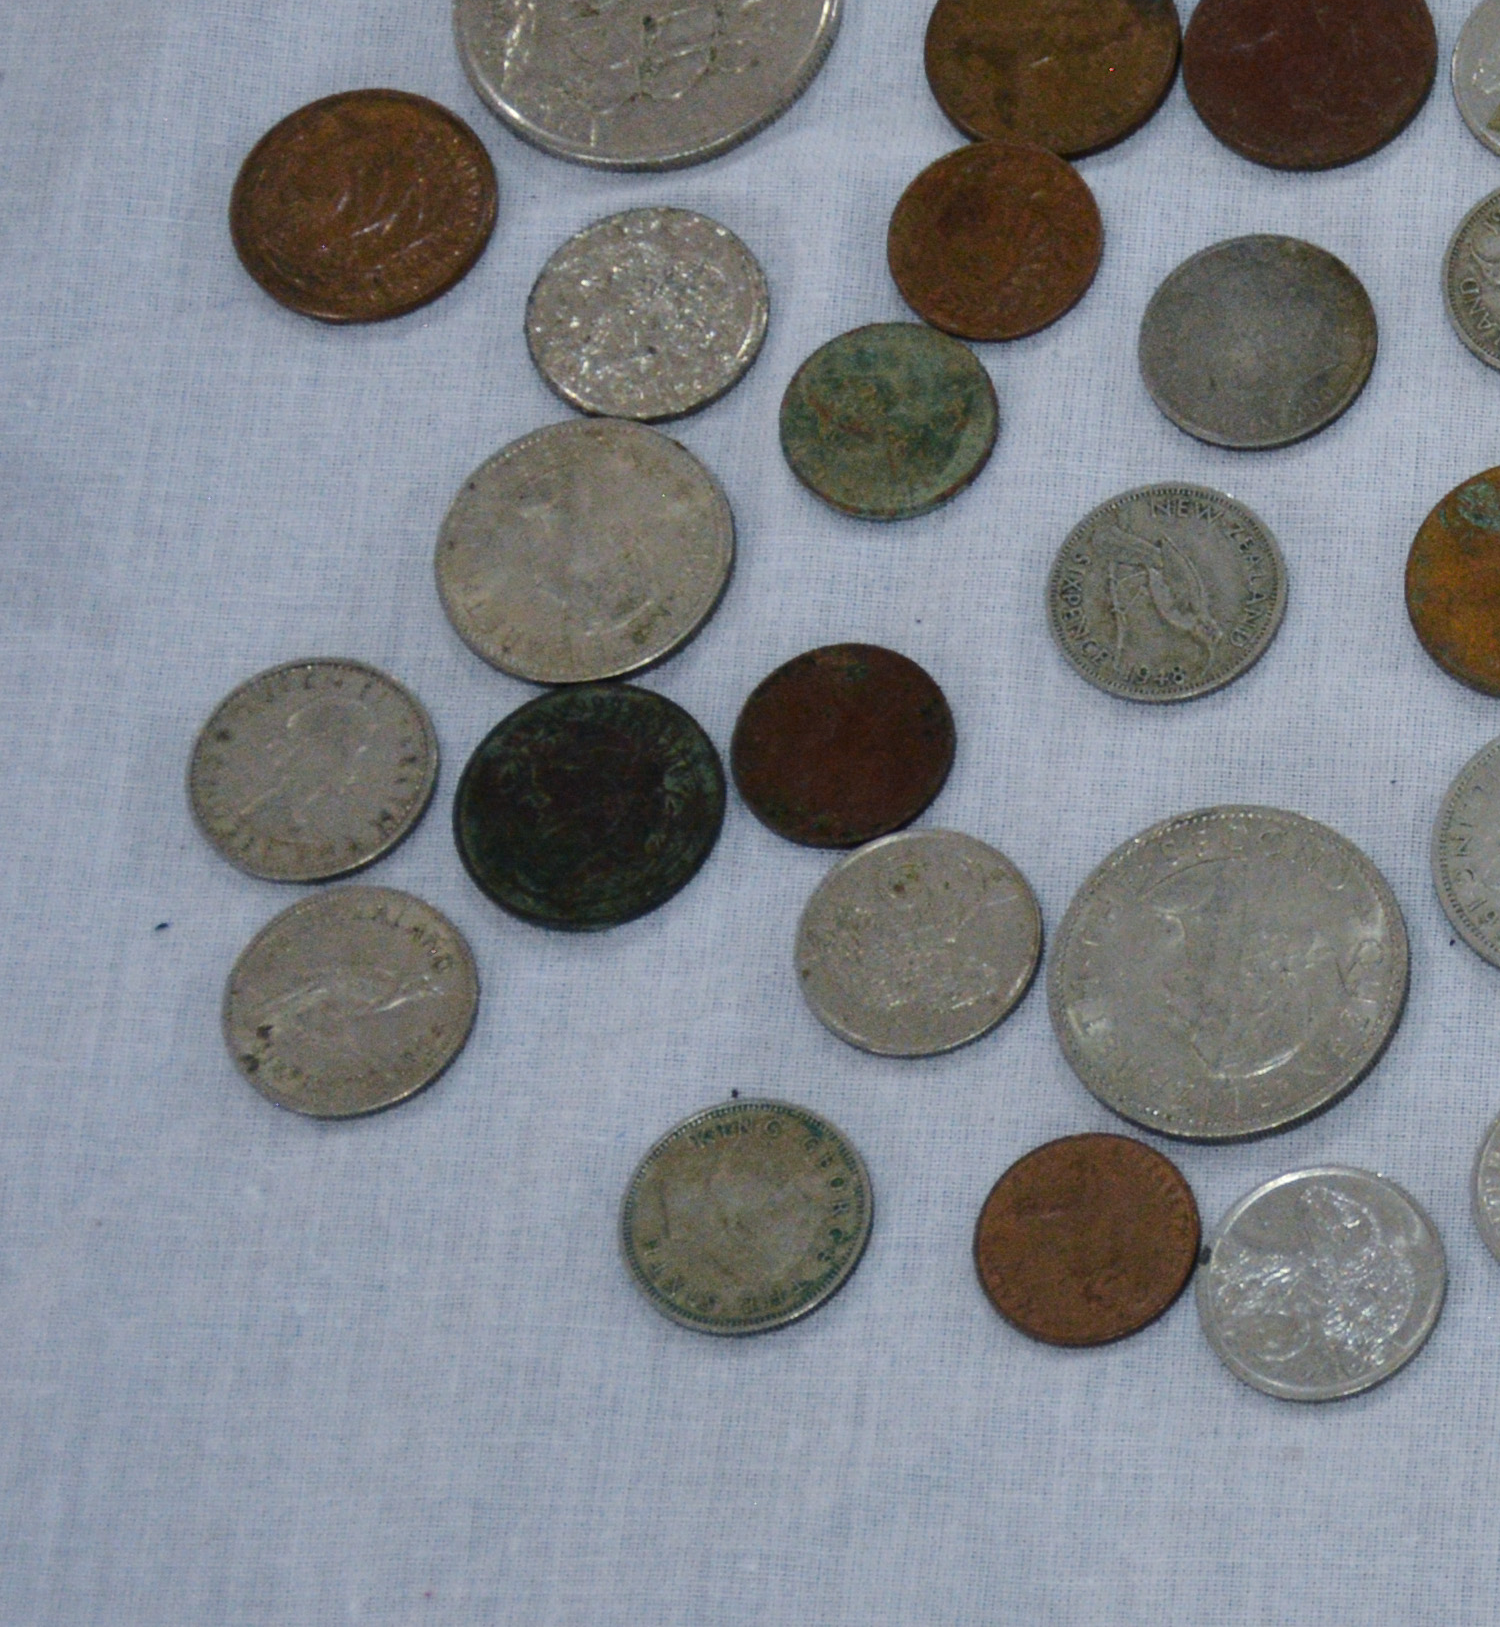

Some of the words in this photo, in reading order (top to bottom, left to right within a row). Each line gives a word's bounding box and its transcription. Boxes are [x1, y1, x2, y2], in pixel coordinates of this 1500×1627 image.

[1057, 551, 1117, 676] SIXPENCE
[1149, 501, 1224, 530] NEW
[1224, 523, 1267, 651] ZEALAND
